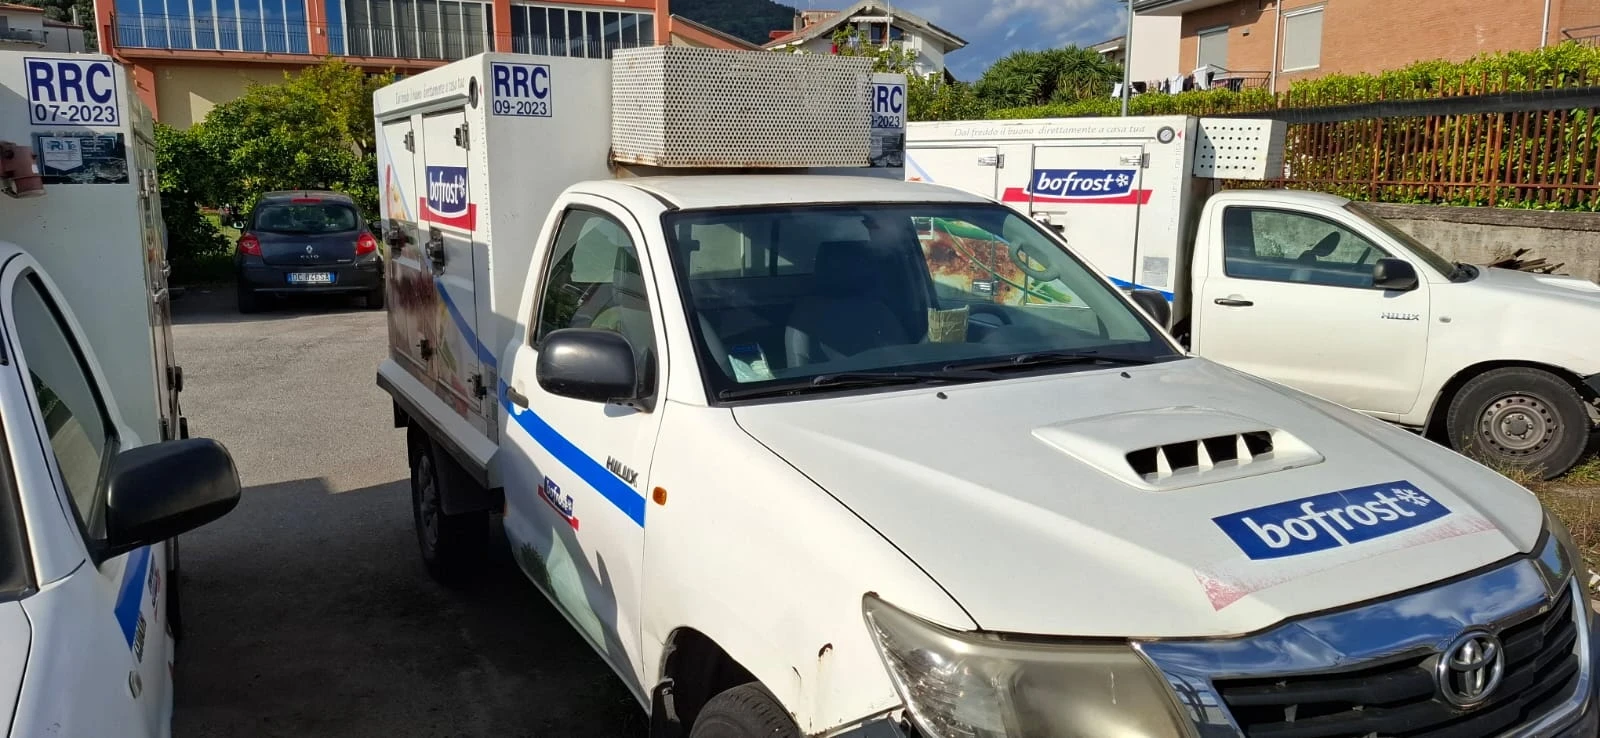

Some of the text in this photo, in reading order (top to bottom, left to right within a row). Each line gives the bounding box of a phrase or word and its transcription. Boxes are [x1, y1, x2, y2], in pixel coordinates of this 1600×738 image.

[29, 61, 113, 103] RRC
[493, 65, 548, 99] RRC
[35, 104, 115, 122] 07-2023
[495, 100, 547, 115] 09-2023
[872, 116, 900, 127] -2023
[430, 170, 459, 212] bofrost
[1037, 171, 1115, 196] bofrost
[1381, 312, 1419, 320] HILUX
[606, 455, 638, 485] HILUX
[1241, 491, 1416, 549] bofrost
